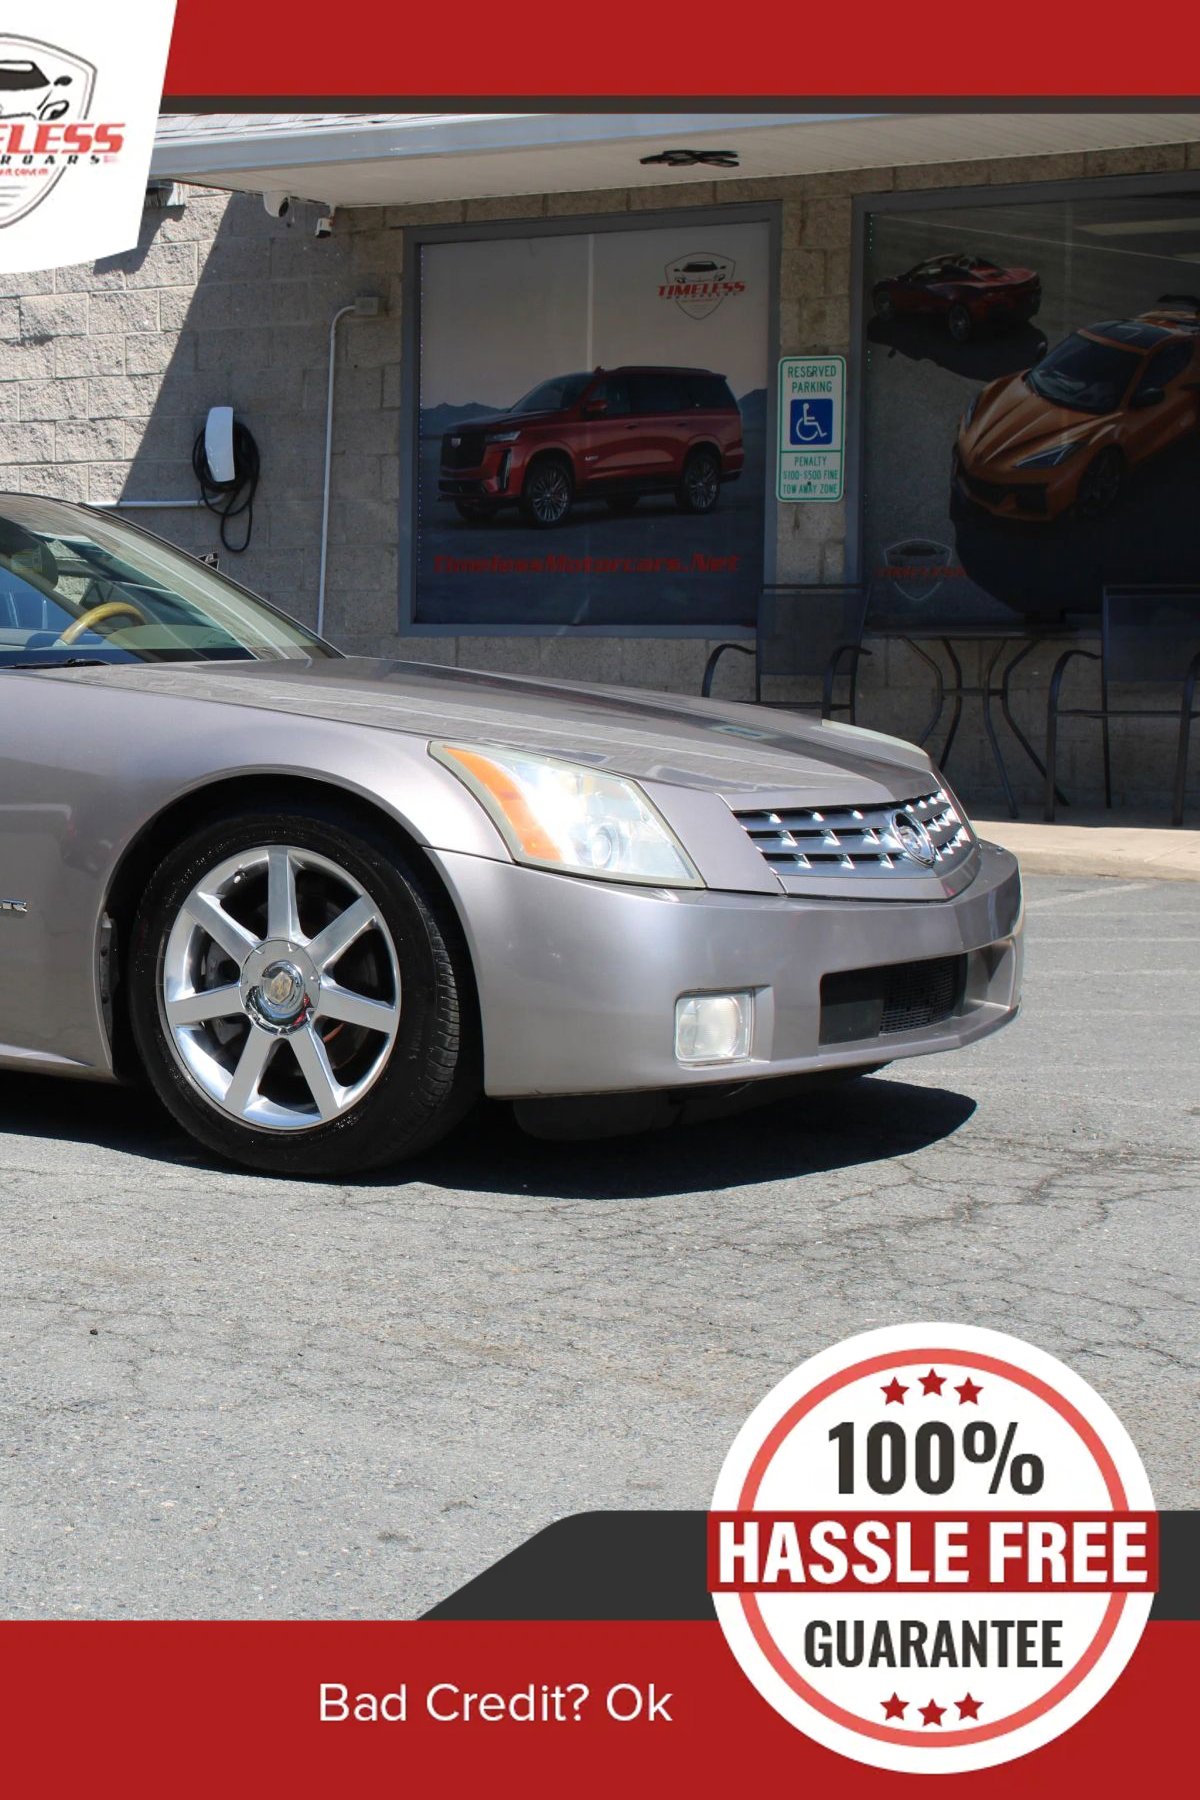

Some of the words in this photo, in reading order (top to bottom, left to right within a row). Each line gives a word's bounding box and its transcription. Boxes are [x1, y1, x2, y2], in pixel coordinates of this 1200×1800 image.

[658, 281, 745, 297] TIMELESS
[788, 365, 837, 378] RESERVED
[792, 381, 832, 393] PARKING
[794, 456, 827, 467] PENALTY
[823, 469, 838, 480] FINE
[783, 484, 797, 494] TOW
[799, 484, 817, 494] AWAY
[819, 484, 838, 494] ZONE
